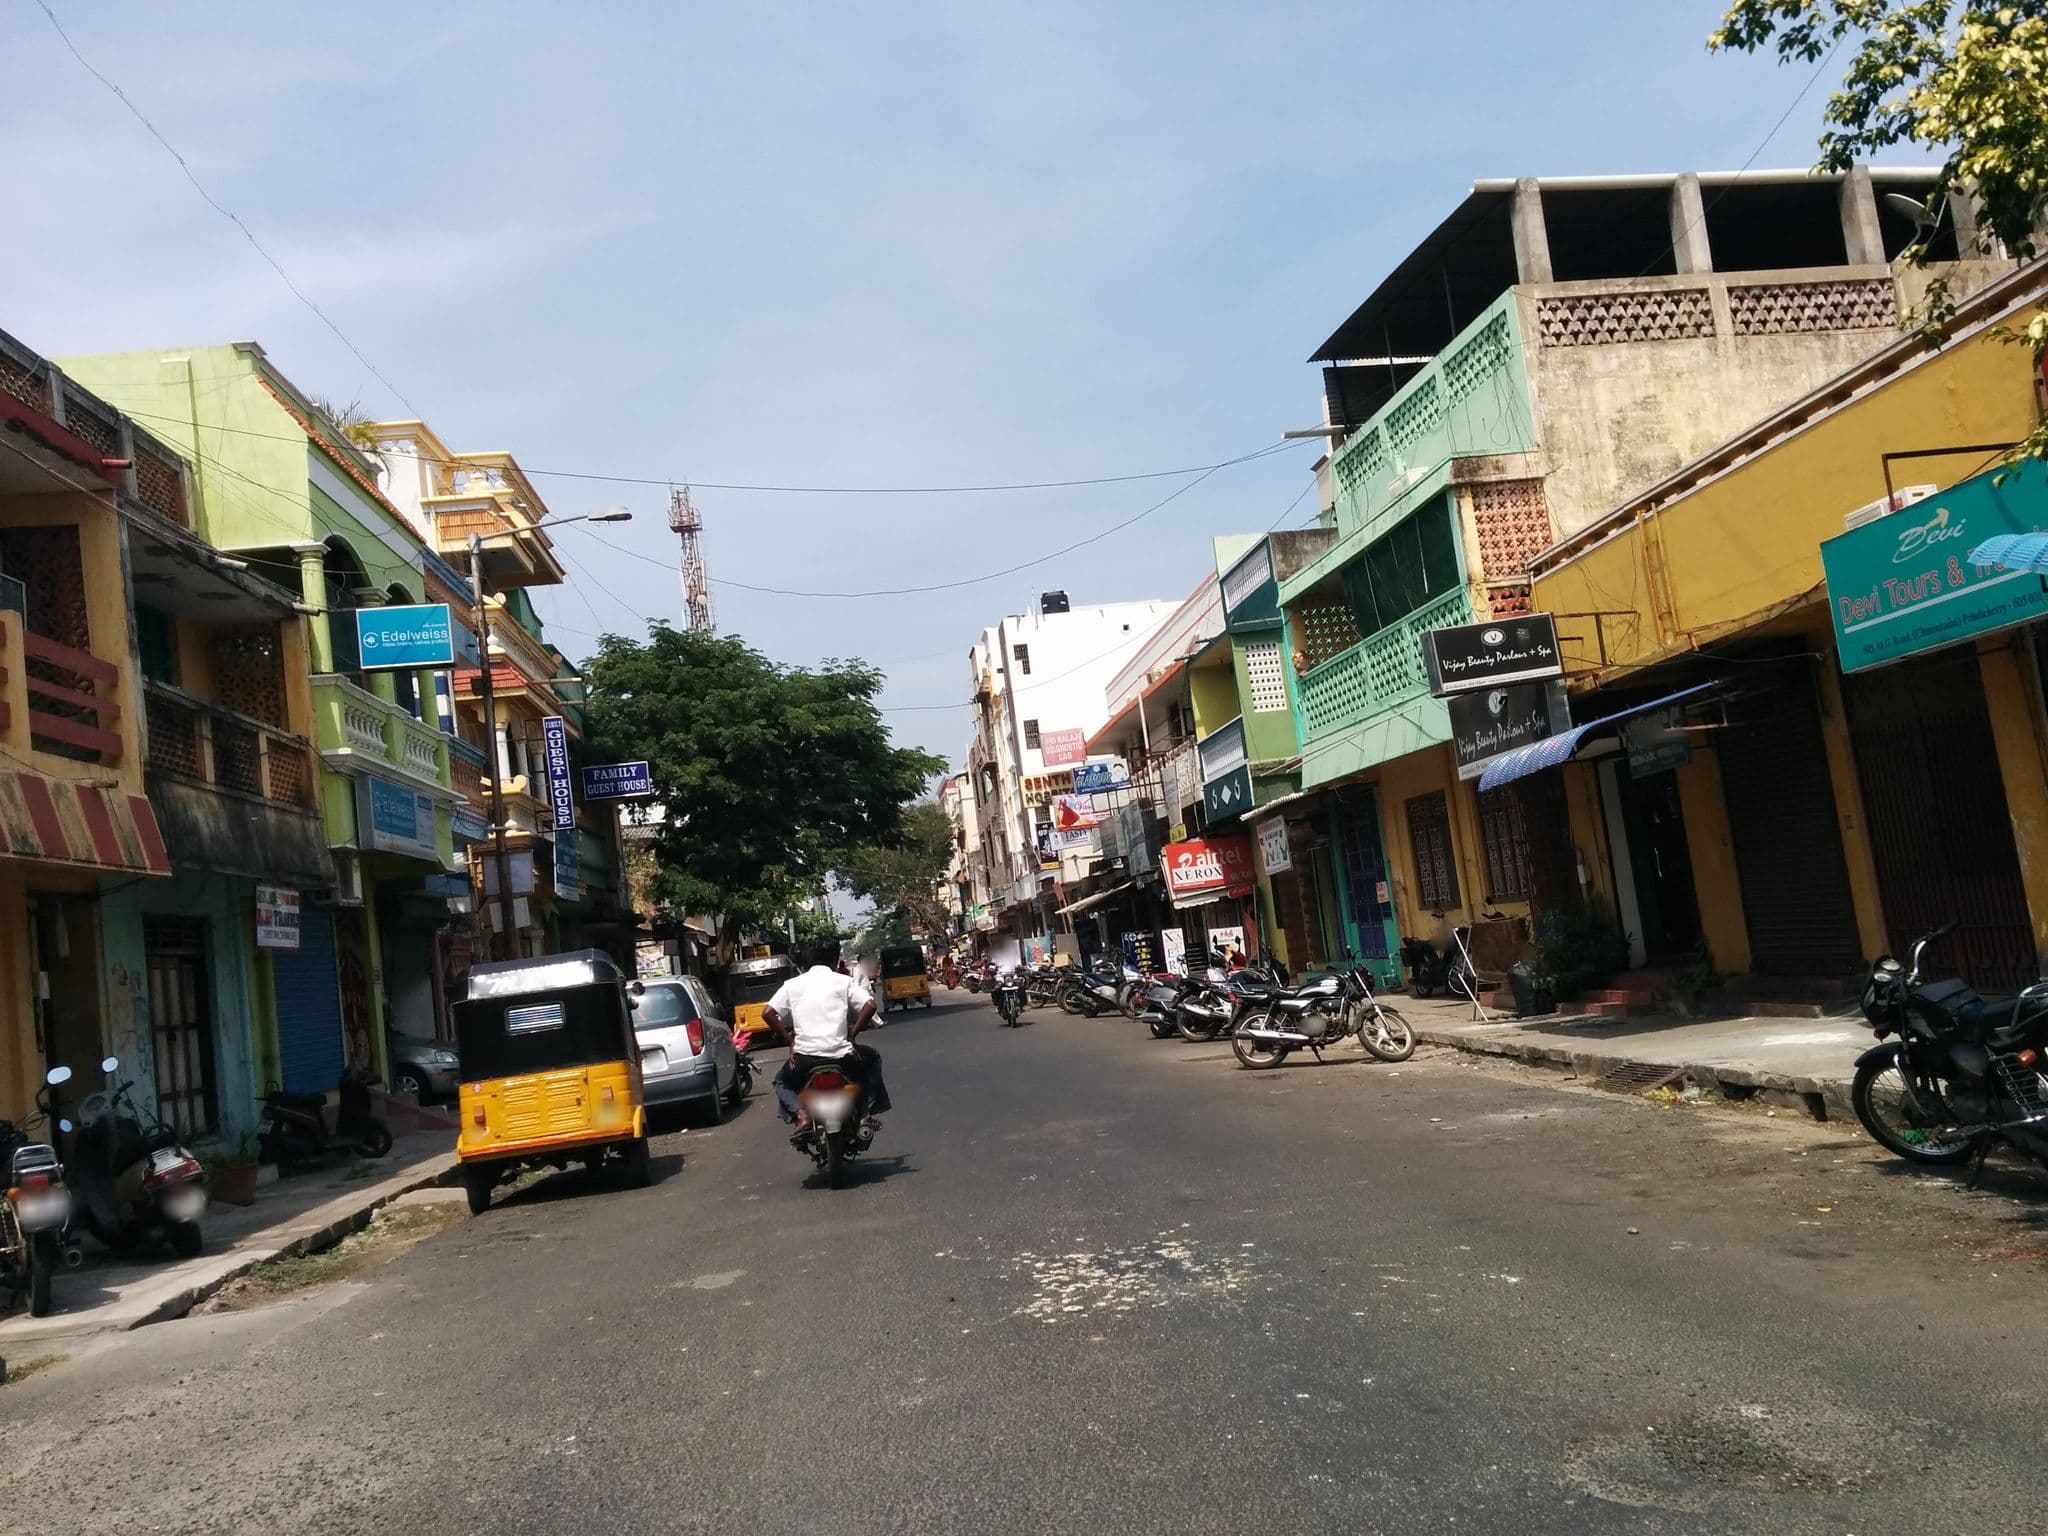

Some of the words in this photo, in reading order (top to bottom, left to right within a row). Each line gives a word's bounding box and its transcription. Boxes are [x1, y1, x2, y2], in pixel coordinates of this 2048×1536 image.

[1893, 519, 1966, 563] Devi
[1838, 586, 1882, 625] Devi
[1883, 569, 1941, 608] Tours
[1947, 556, 1966, 586] &
[381, 629, 448, 642] Edelweiss
[1442, 659, 1466, 672] Vijay
[1467, 655, 1495, 667] Beauty
[1496, 649, 1527, 662] Parlour
[1537, 645, 1552, 658] Spa
[1458, 738, 1476, 760] Vijay
[1475, 730, 1497, 751] Beauty
[1532, 709, 1546, 736] Spa
[548, 730, 566, 775] GUEST
[1058, 751, 1072, 760] LAB
[593, 766, 638, 780] FAMILY
[1024, 772, 1072, 791] SENTH
[587, 782, 616, 795] GUEST
[617, 779, 647, 792] HOUSE
[553, 779, 572, 825] HOUSE
[1196, 846, 1241, 869] airtel
[1174, 866, 1223, 881] XEROX
